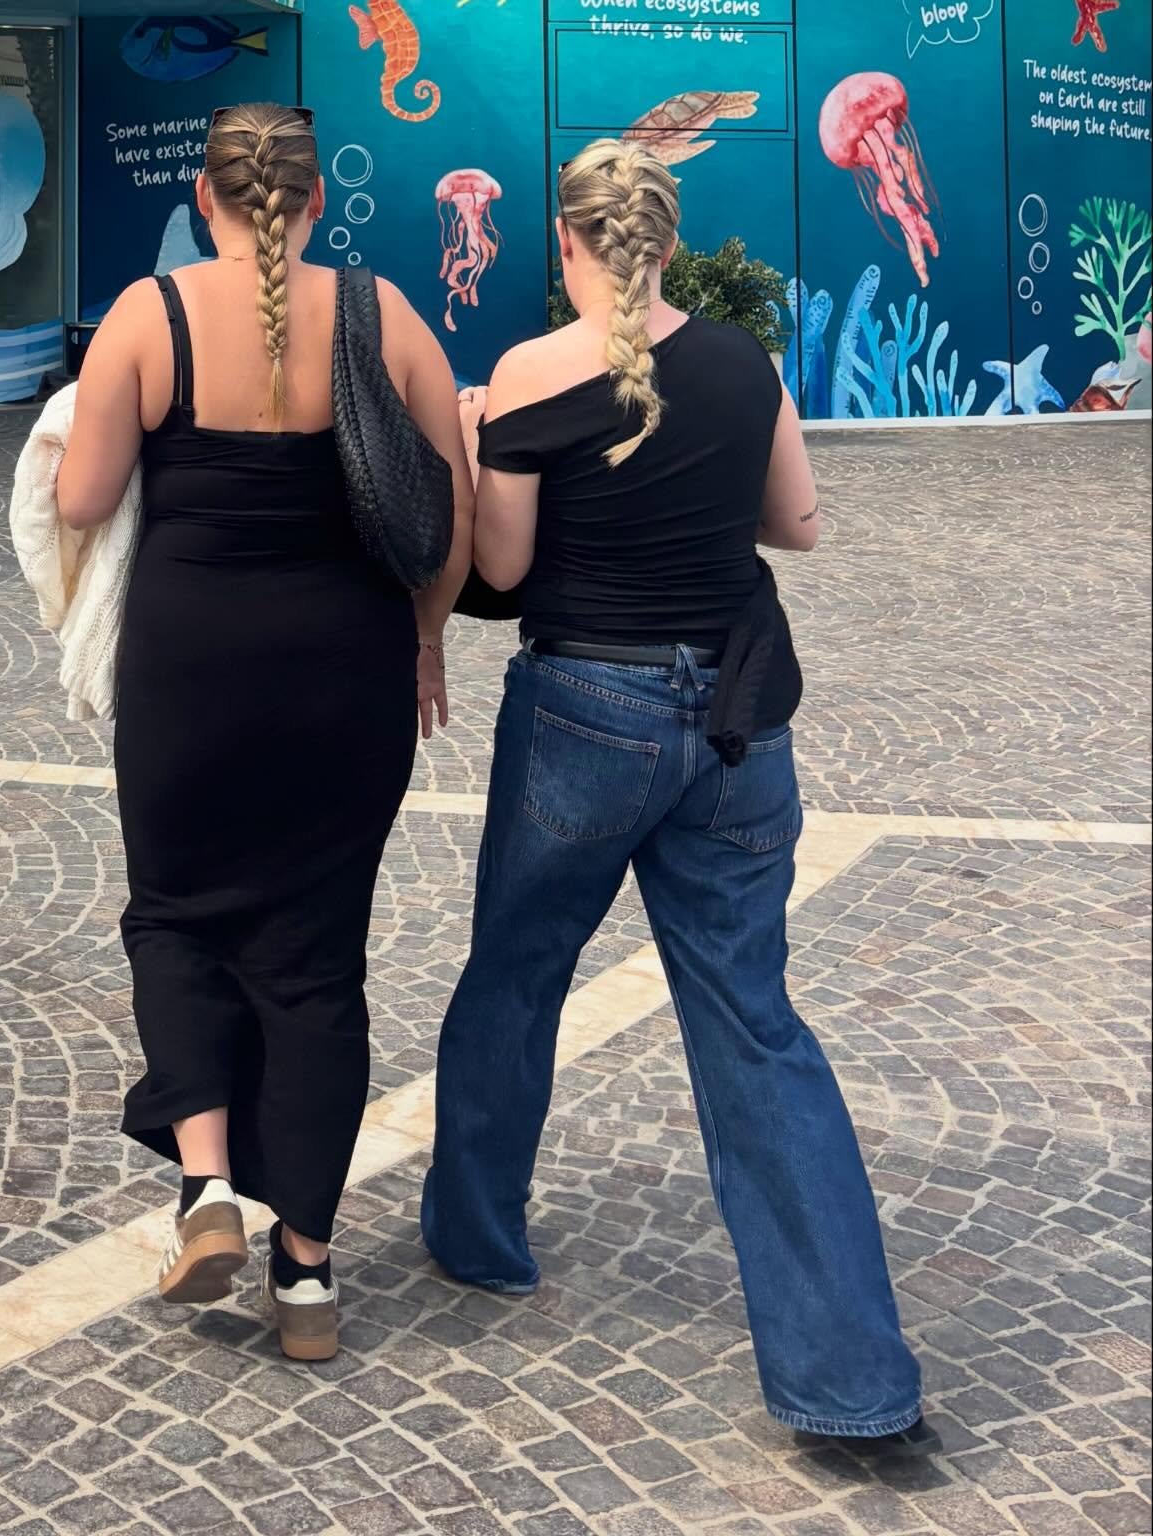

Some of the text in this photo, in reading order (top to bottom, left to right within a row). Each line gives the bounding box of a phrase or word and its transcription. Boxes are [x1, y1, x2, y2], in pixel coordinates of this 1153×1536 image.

[920, 1, 968, 28] bloop
[589, 14, 749, 45] thrive, so do we.
[1023, 58, 1047, 80] The
[1050, 64, 1088, 85] oldest
[1039, 87, 1146, 117] on Earth are still
[106, 116, 208, 142] Some marine
[1030, 109, 1152, 143] shaping the future.
[115, 146, 151, 165] have
[132, 168, 172, 187] than
